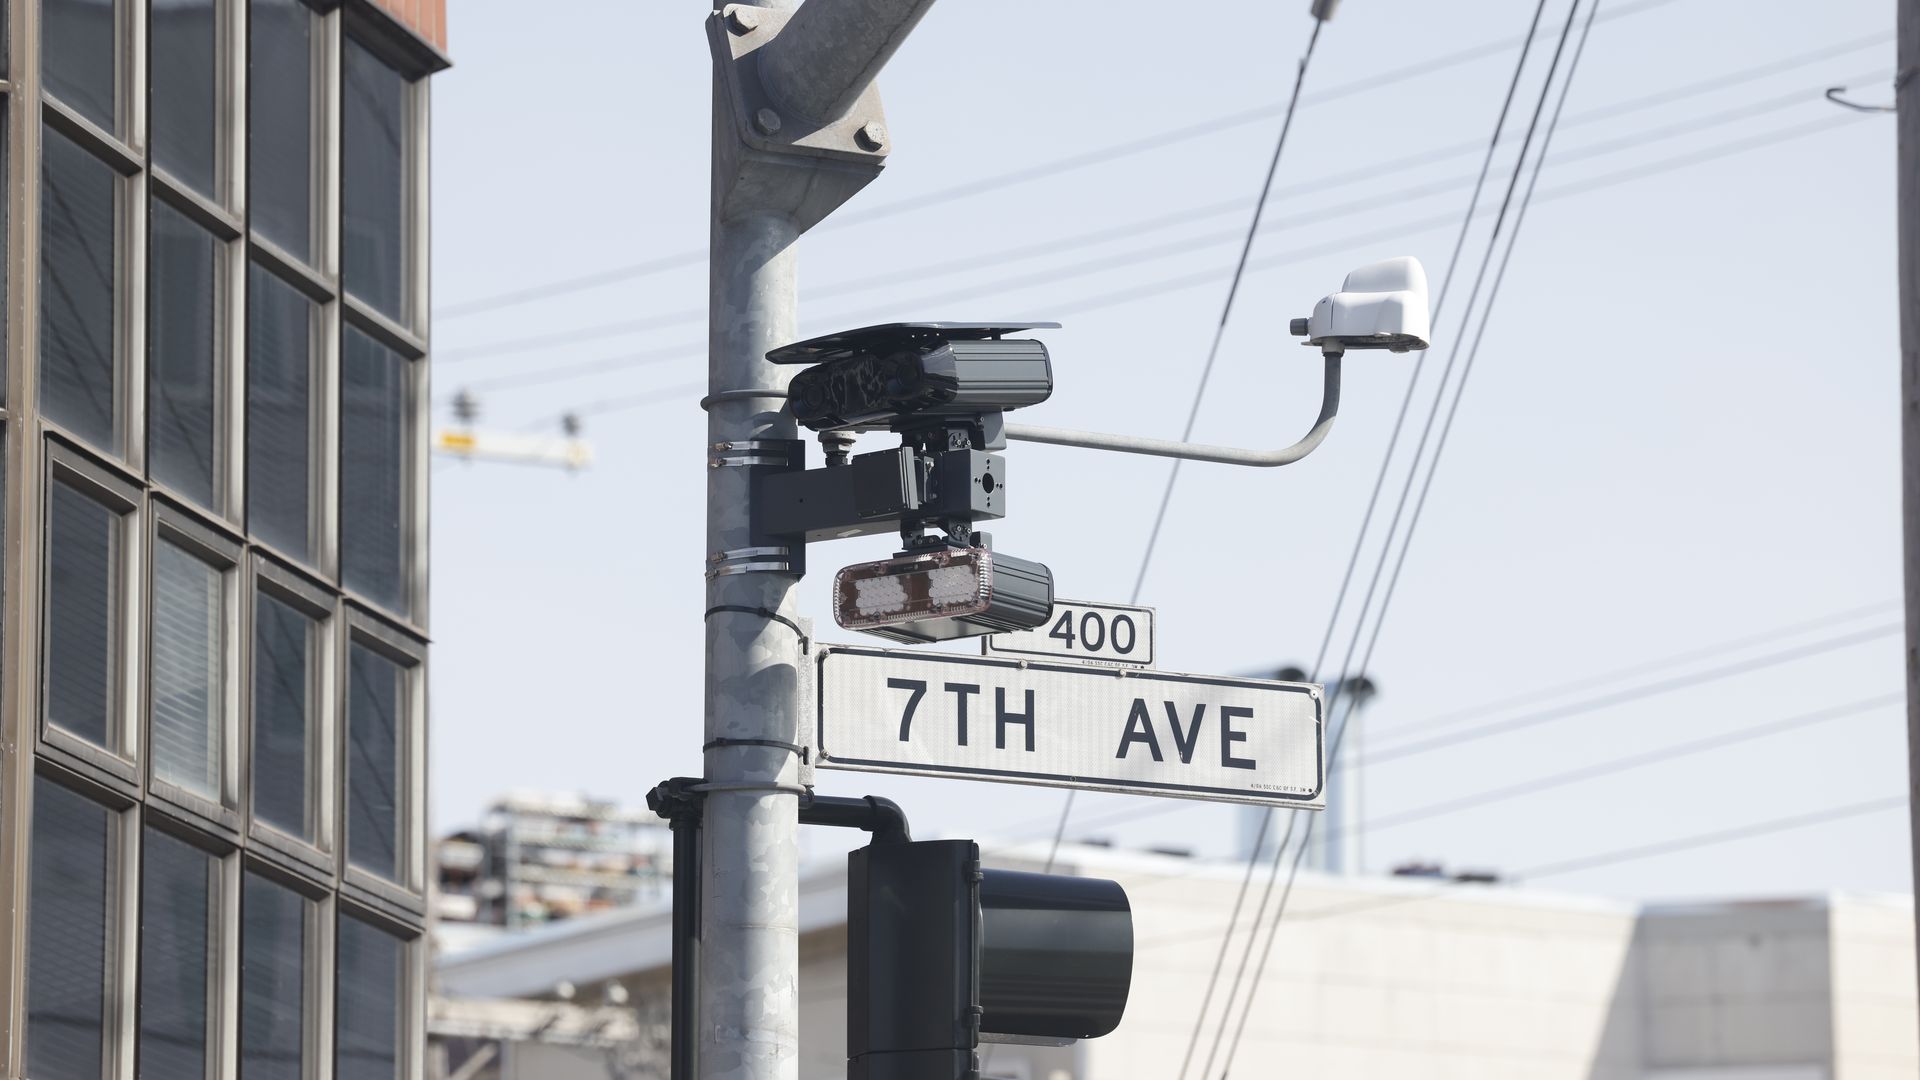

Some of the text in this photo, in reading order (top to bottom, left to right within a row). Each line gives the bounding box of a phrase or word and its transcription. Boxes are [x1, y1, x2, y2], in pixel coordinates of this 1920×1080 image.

[1049, 610, 1135, 654] 400
[887, 678, 1256, 770] 7TH AVE
